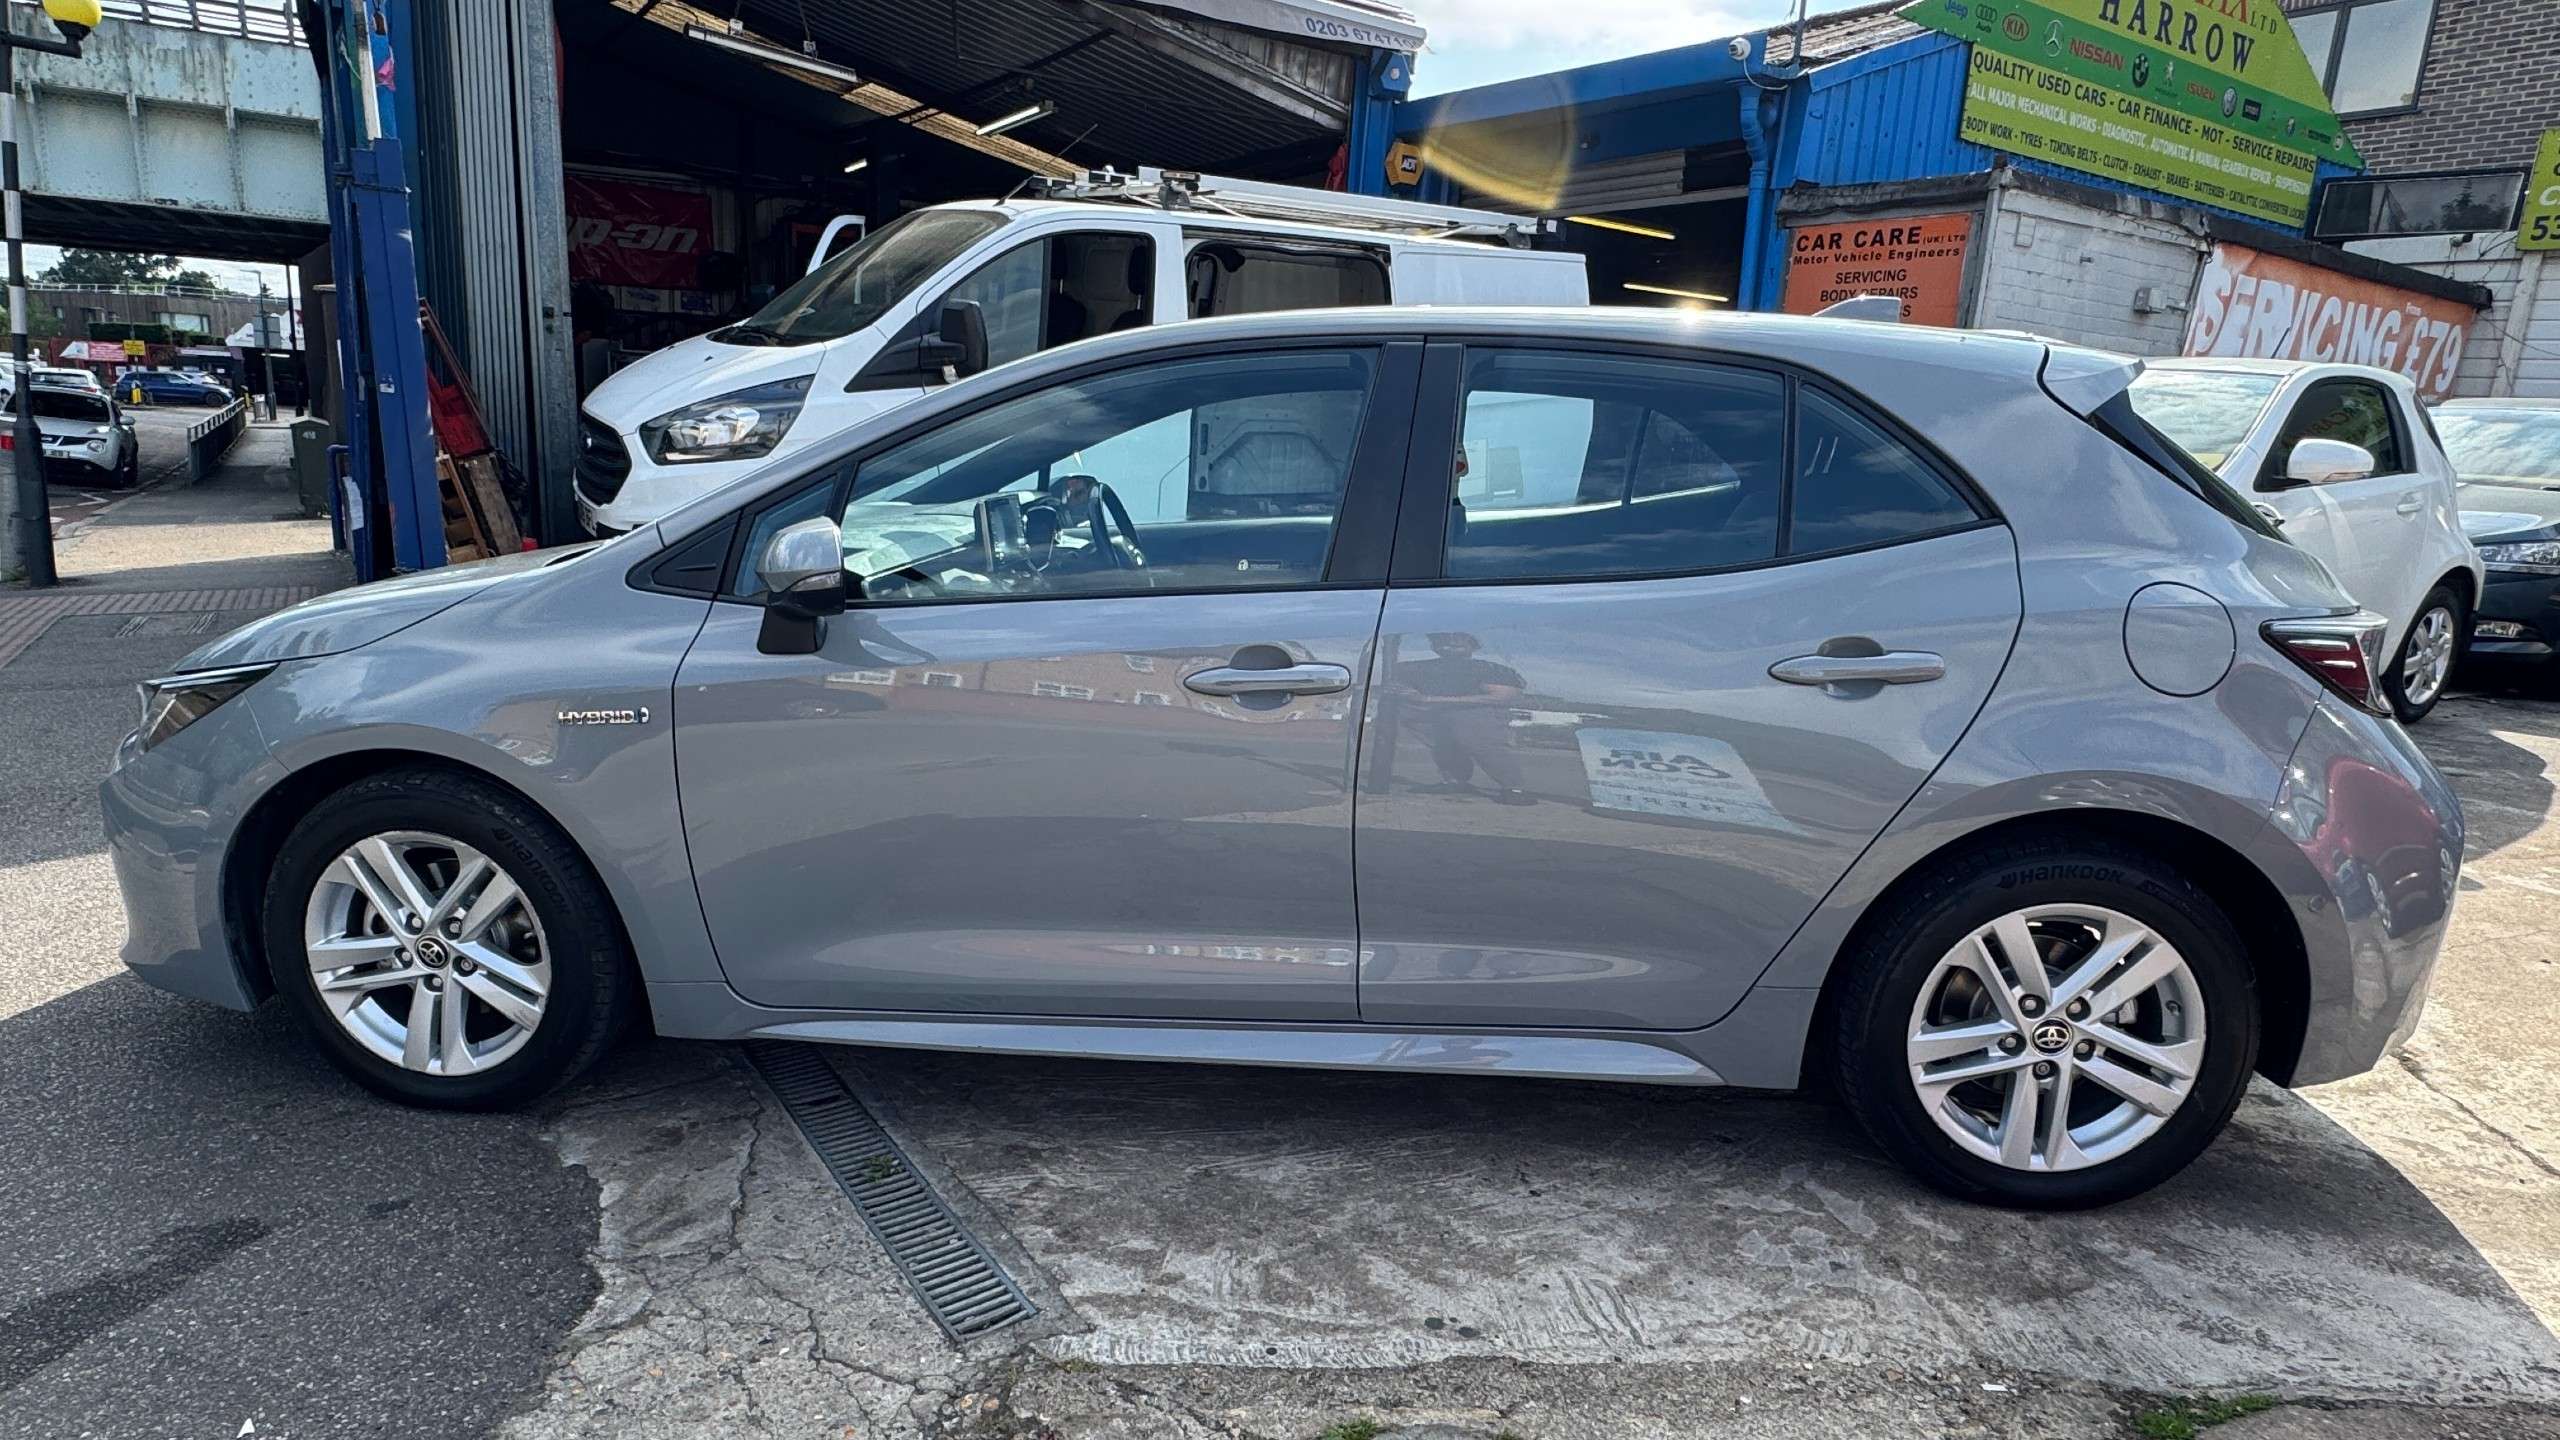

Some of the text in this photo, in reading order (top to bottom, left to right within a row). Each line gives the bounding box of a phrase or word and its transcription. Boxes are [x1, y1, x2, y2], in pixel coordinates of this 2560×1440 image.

[1305, 17, 1349, 38] 0203
[2006, 18, 2026, 36] KIA
[2098, 0, 2255, 73] HARROW
[2250, 11, 2277, 35] LTD
[2069, 38, 2124, 70] NISSAN
[1970, 83, 1985, 100] ALL
[1988, 87, 2016, 110] MAJOR
[2018, 95, 2067, 124] MECHANICAL
[2069, 112, 2097, 133] WORKS
[1973, 51, 2315, 173] QUALITY USED CARS CAR FINANCE MOT SERVICE REPAIRS
[1966, 116, 1989, 133] BODY
[1989, 122, 2014, 140] WORK
[2020, 131, 2044, 149] TYRES
[2050, 140, 2076, 159] TIMING
[2076, 147, 2097, 163] BELTS
[2103, 154, 2129, 172] CLUTCH
[2133, 163, 2161, 182] EXHAUST
[567, 216, 698, 253] p-on
[1796, 225, 1966, 252] CAR CARE (UK) LTD
[1793, 247, 1960, 266] Motor Vehicle Engineers
[1835, 269, 1907, 285] SERVICING
[1820, 289, 1857, 302] BODY
[2188, 258, 2463, 393] SERVICING £79
[558, 710, 635, 725] HYBRID
